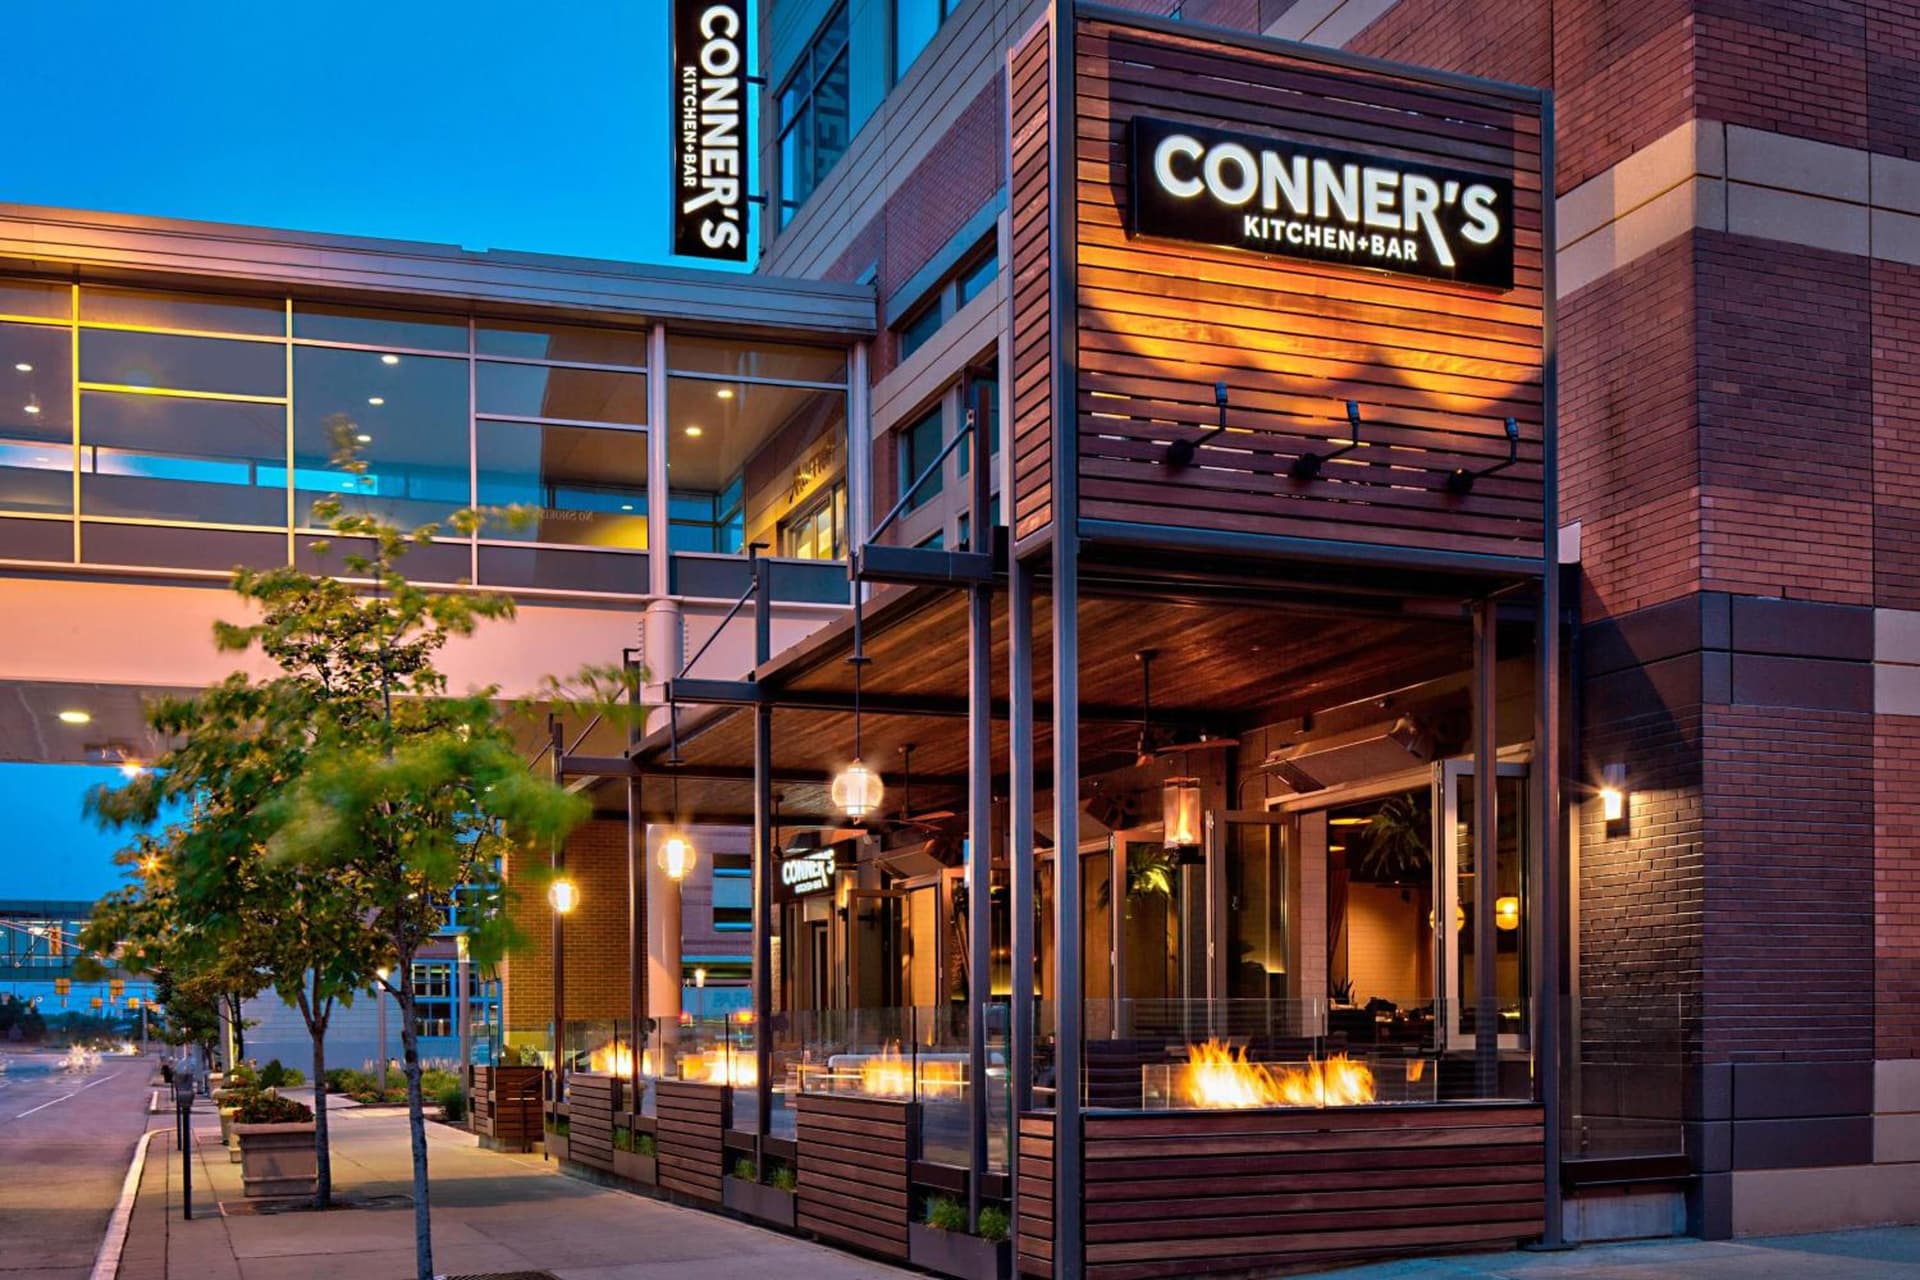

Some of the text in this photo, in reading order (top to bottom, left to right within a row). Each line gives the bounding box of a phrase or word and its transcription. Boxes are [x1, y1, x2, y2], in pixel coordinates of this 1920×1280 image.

[683, 66, 697, 187] KITCHEN+BAR
[684, 5, 740, 249] CONNER'S
[1154, 134, 1499, 267] CONNER'S
[1243, 214, 1418, 262] KITCHEN+BAR
